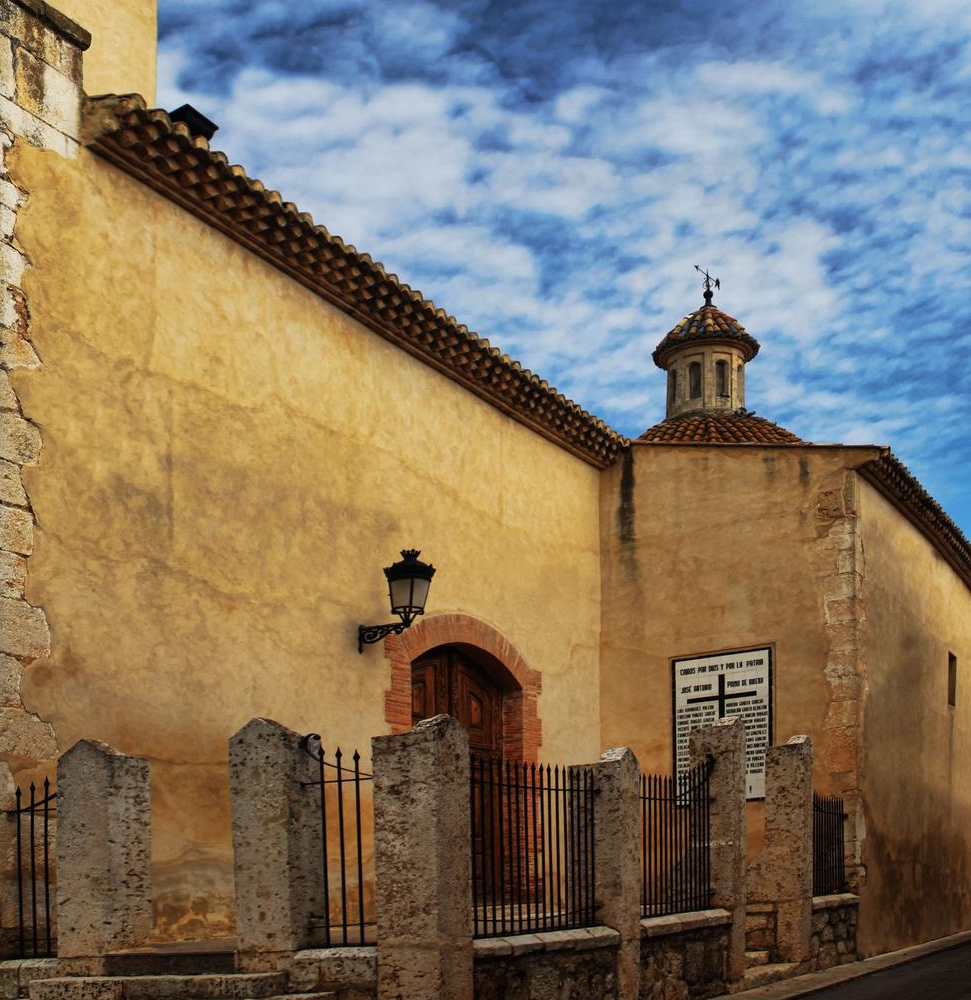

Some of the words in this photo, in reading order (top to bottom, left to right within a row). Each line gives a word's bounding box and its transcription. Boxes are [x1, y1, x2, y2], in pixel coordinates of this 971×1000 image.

[746, 659, 763, 667] PATRIA
[681, 685, 692, 694] JOSÉ
[694, 684, 712, 692] ANTONIO
